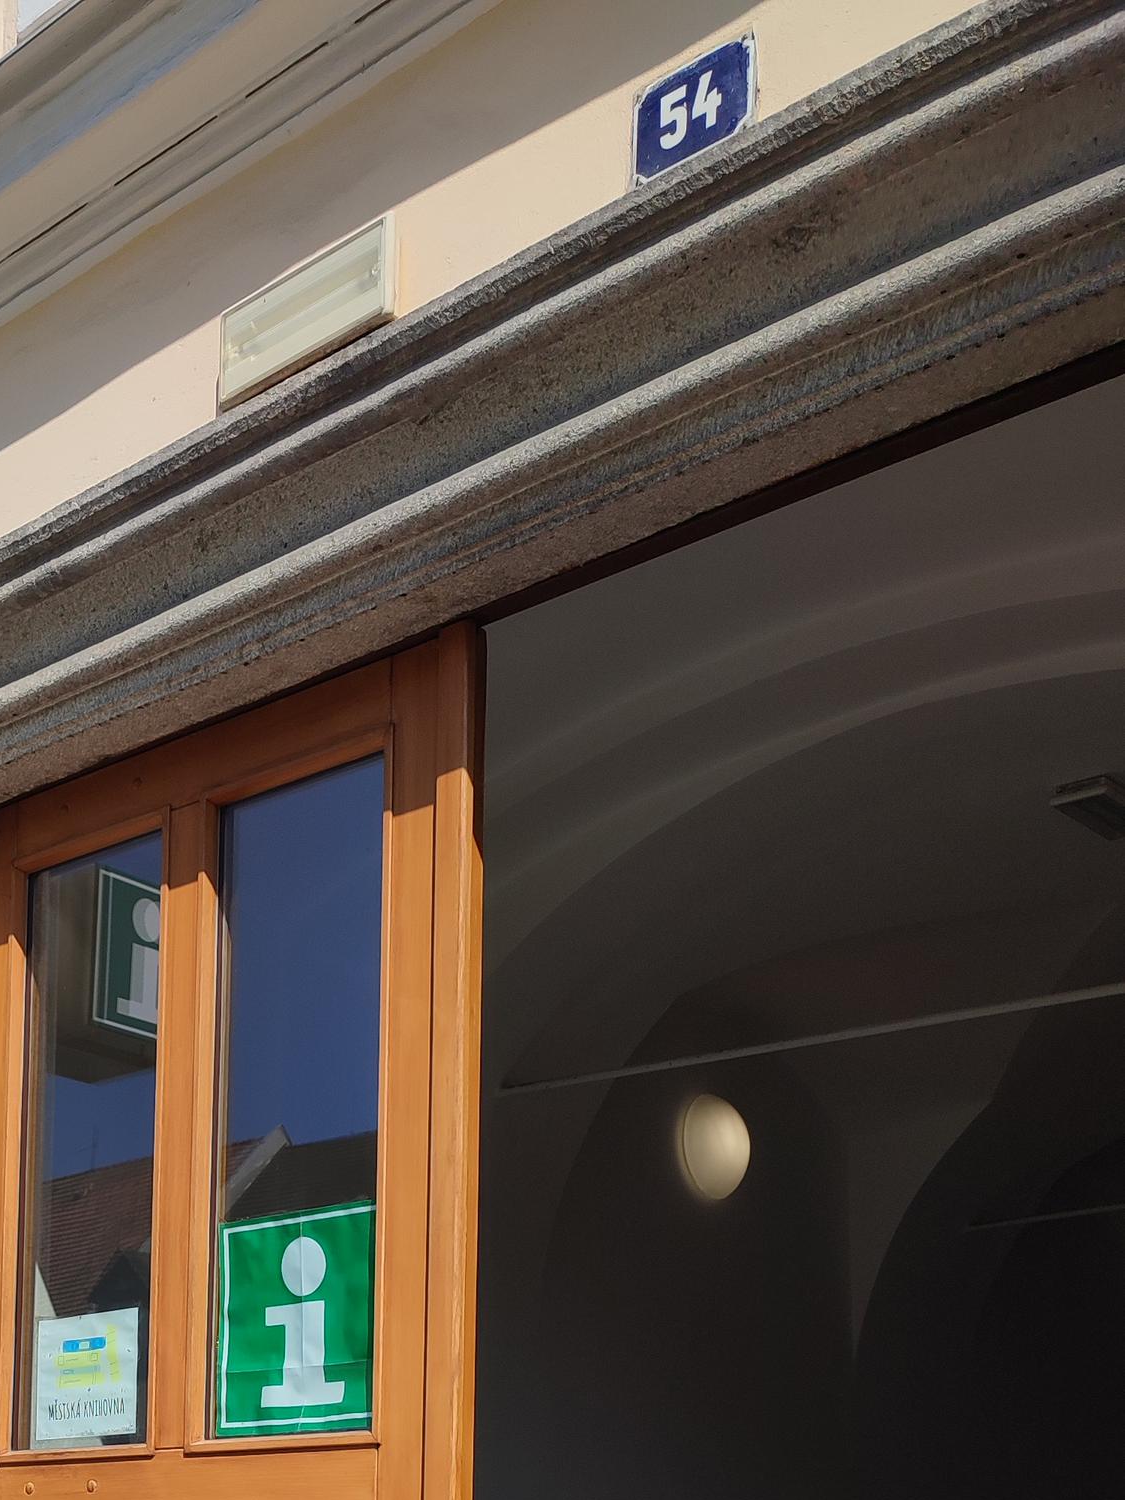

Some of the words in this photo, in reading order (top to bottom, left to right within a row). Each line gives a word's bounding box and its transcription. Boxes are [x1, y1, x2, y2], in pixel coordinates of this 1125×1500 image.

[659, 70, 723, 150] 54
[48, 1398, 81, 1420] MĚSTSKÁ
[83, 1397, 125, 1418] KNIHOVNA
